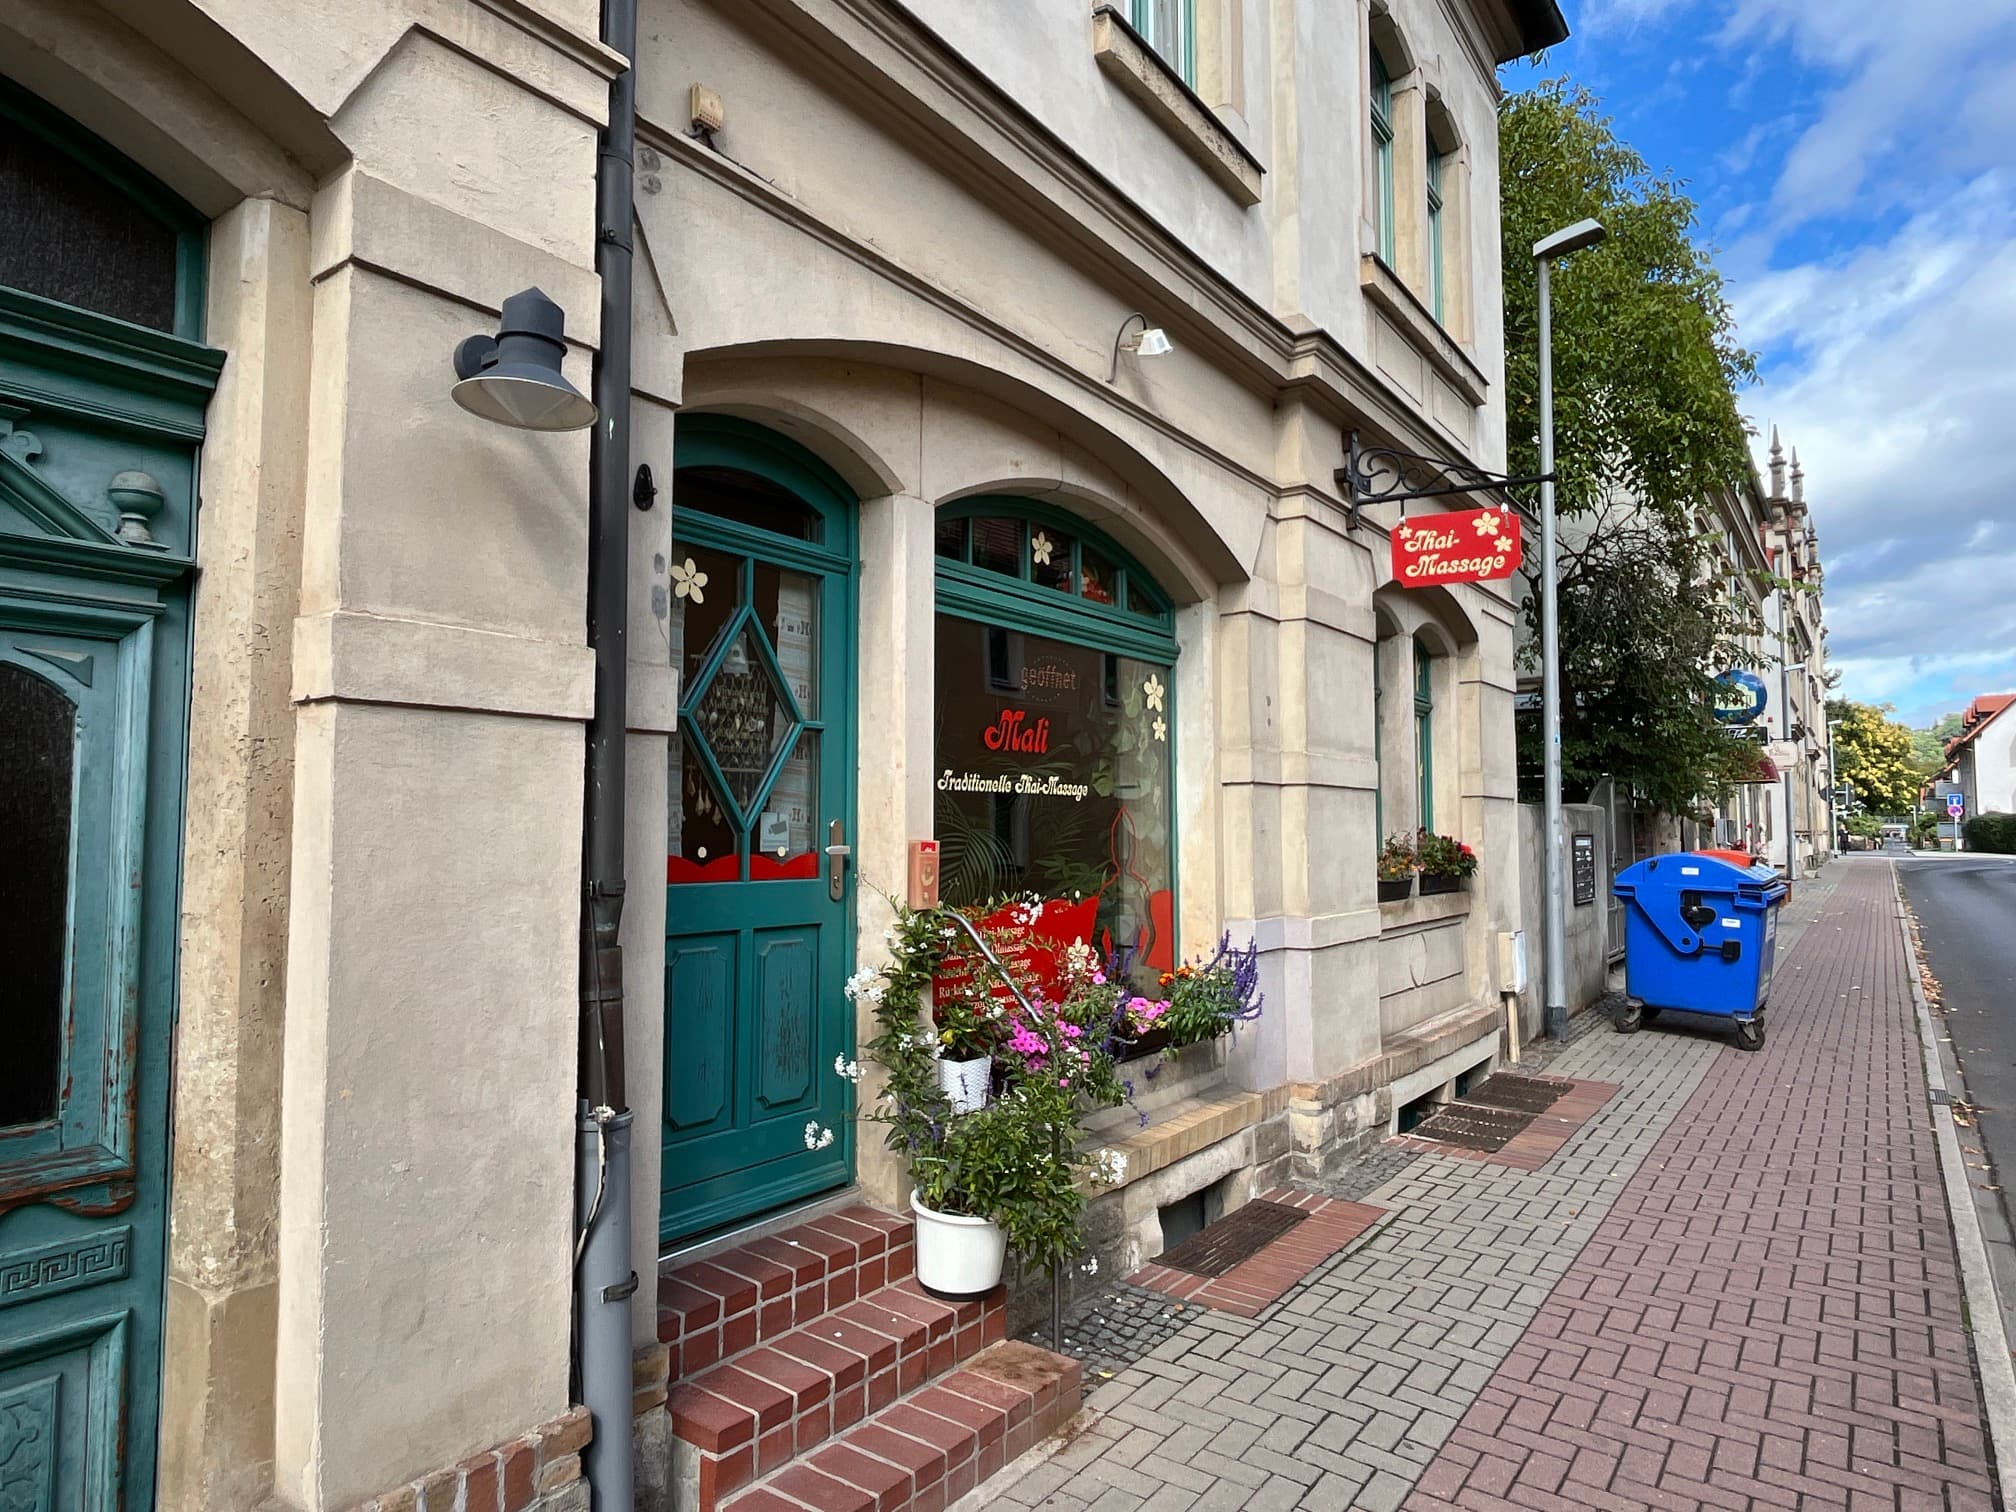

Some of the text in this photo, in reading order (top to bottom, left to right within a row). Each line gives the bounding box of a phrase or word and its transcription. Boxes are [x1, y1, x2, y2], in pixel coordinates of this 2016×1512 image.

[1404, 529, 1460, 552] Thai-
[1405, 553, 1506, 577] Massage
[1020, 665, 1077, 690] geöffnet
[984, 709, 1050, 754] Mali
[936, 769, 1089, 802] Traditionelle Thai-Massage
